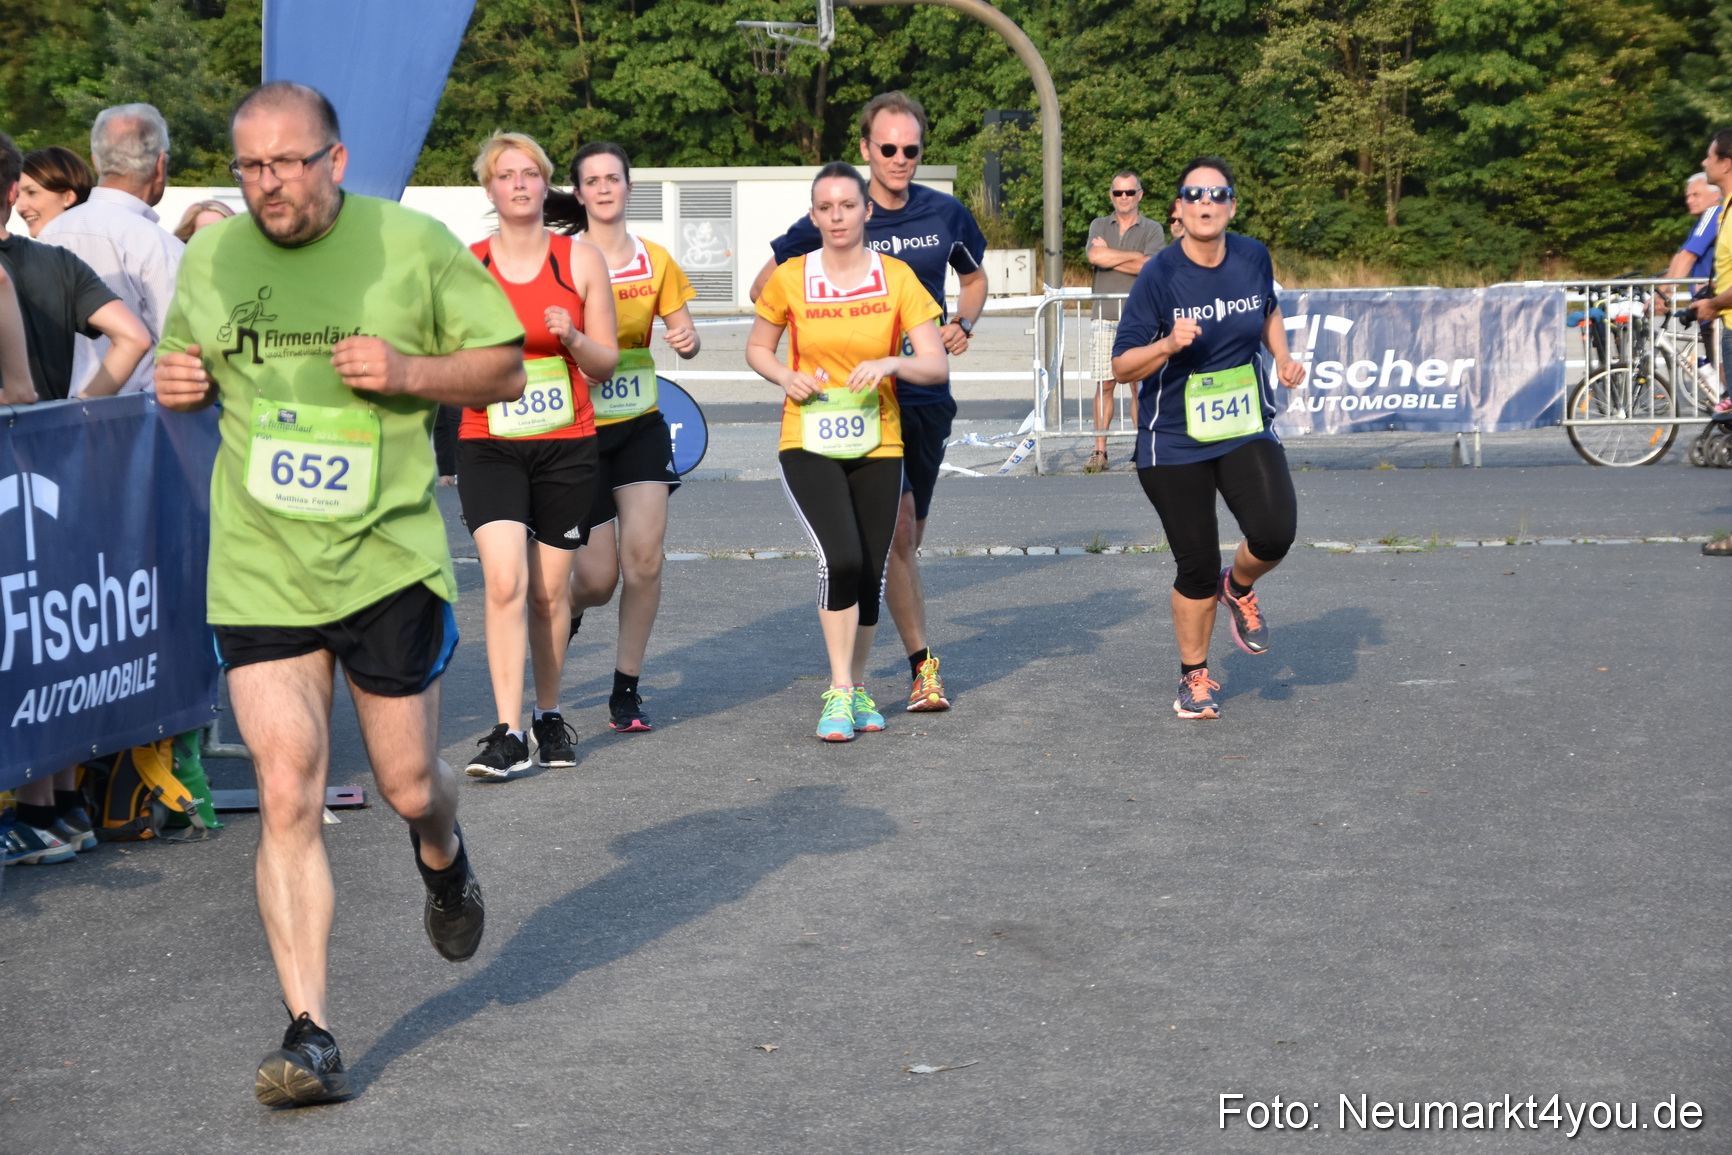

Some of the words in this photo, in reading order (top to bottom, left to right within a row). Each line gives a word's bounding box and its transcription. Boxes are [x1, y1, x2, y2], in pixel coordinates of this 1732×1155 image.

[903, 234, 940, 249] POLES
[618, 284, 657, 300] BÖGL
[805, 307, 844, 319] MAX
[849, 302, 891, 317] BÖGL
[601, 375, 640, 399] 861
[501, 387, 564, 417] 1388
[1195, 393, 1250, 423] 1541
[1287, 393, 1458, 413] AUTOMOBILE
[818, 415, 865, 440] 889
[270, 449, 350, 491] 652
[11, 653, 157, 728] AUTOMOBILE
